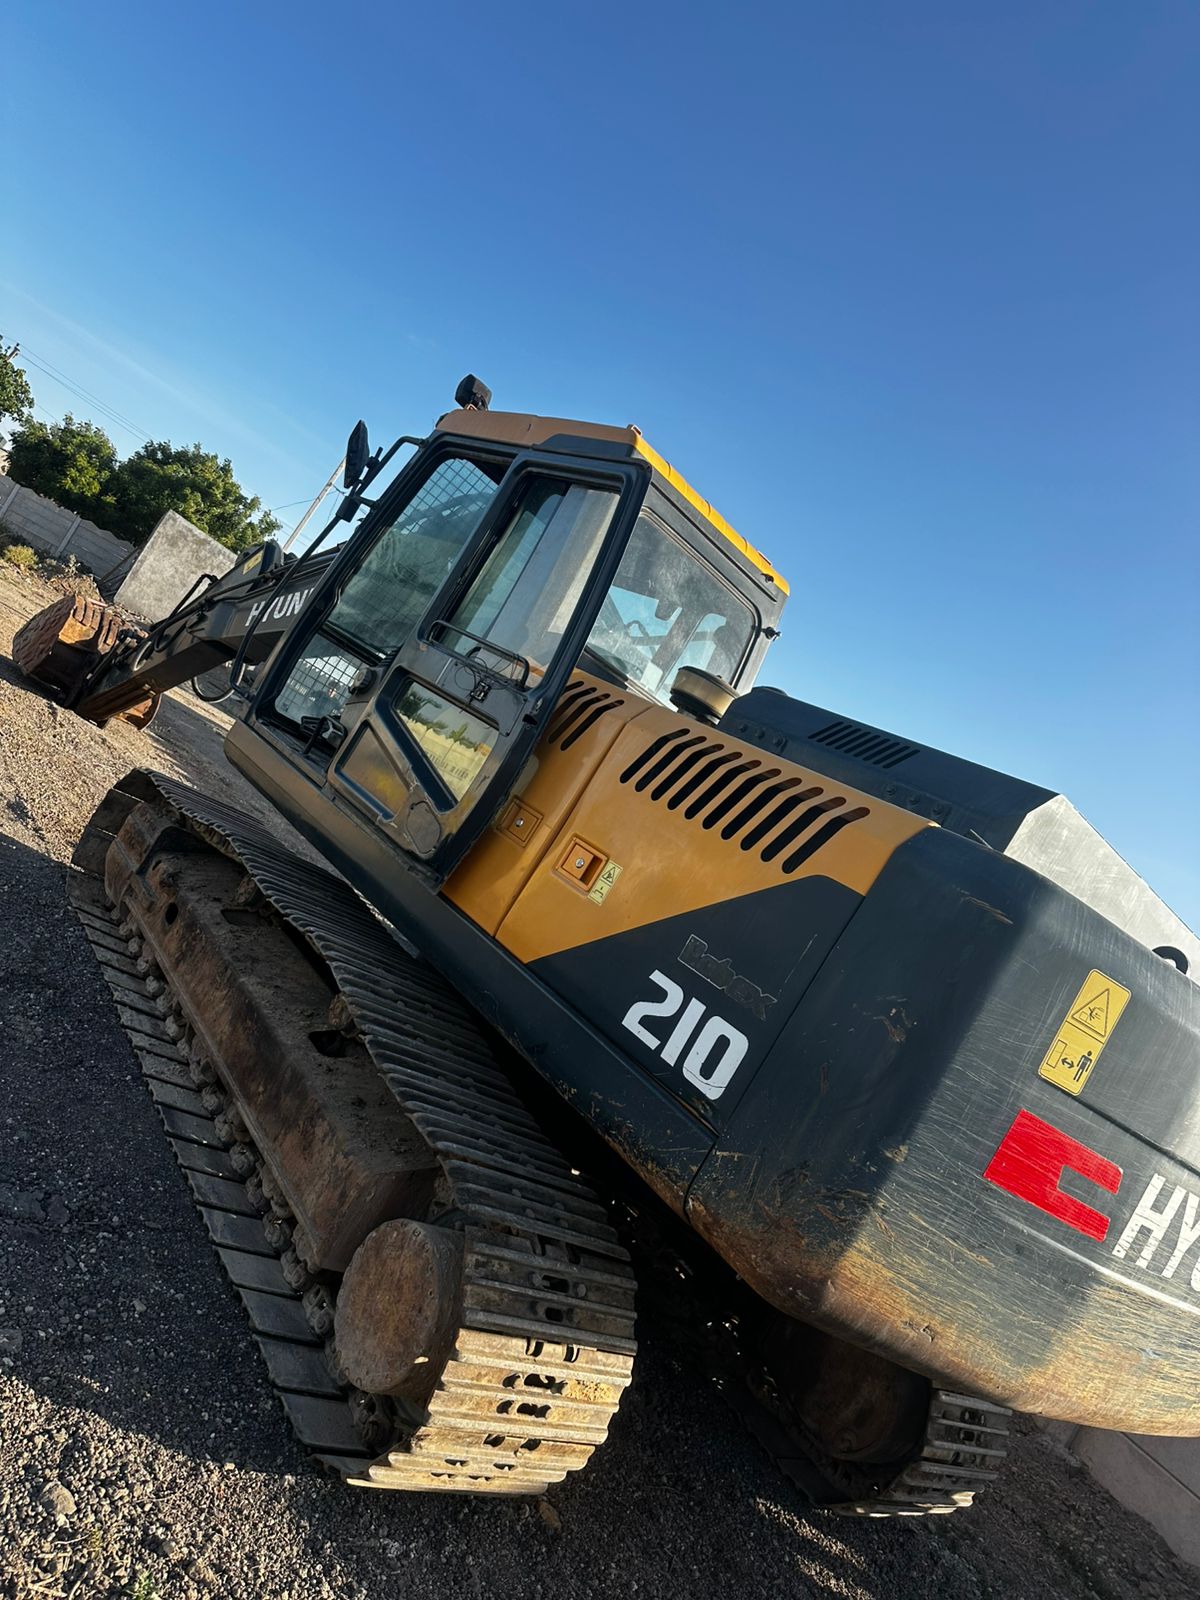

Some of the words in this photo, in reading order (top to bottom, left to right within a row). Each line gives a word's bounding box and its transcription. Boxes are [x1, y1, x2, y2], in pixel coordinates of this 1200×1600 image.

[245, 588, 315, 627] HYUN
[621, 969, 749, 1100] 210
[1112, 1173, 1200, 1292] HY
